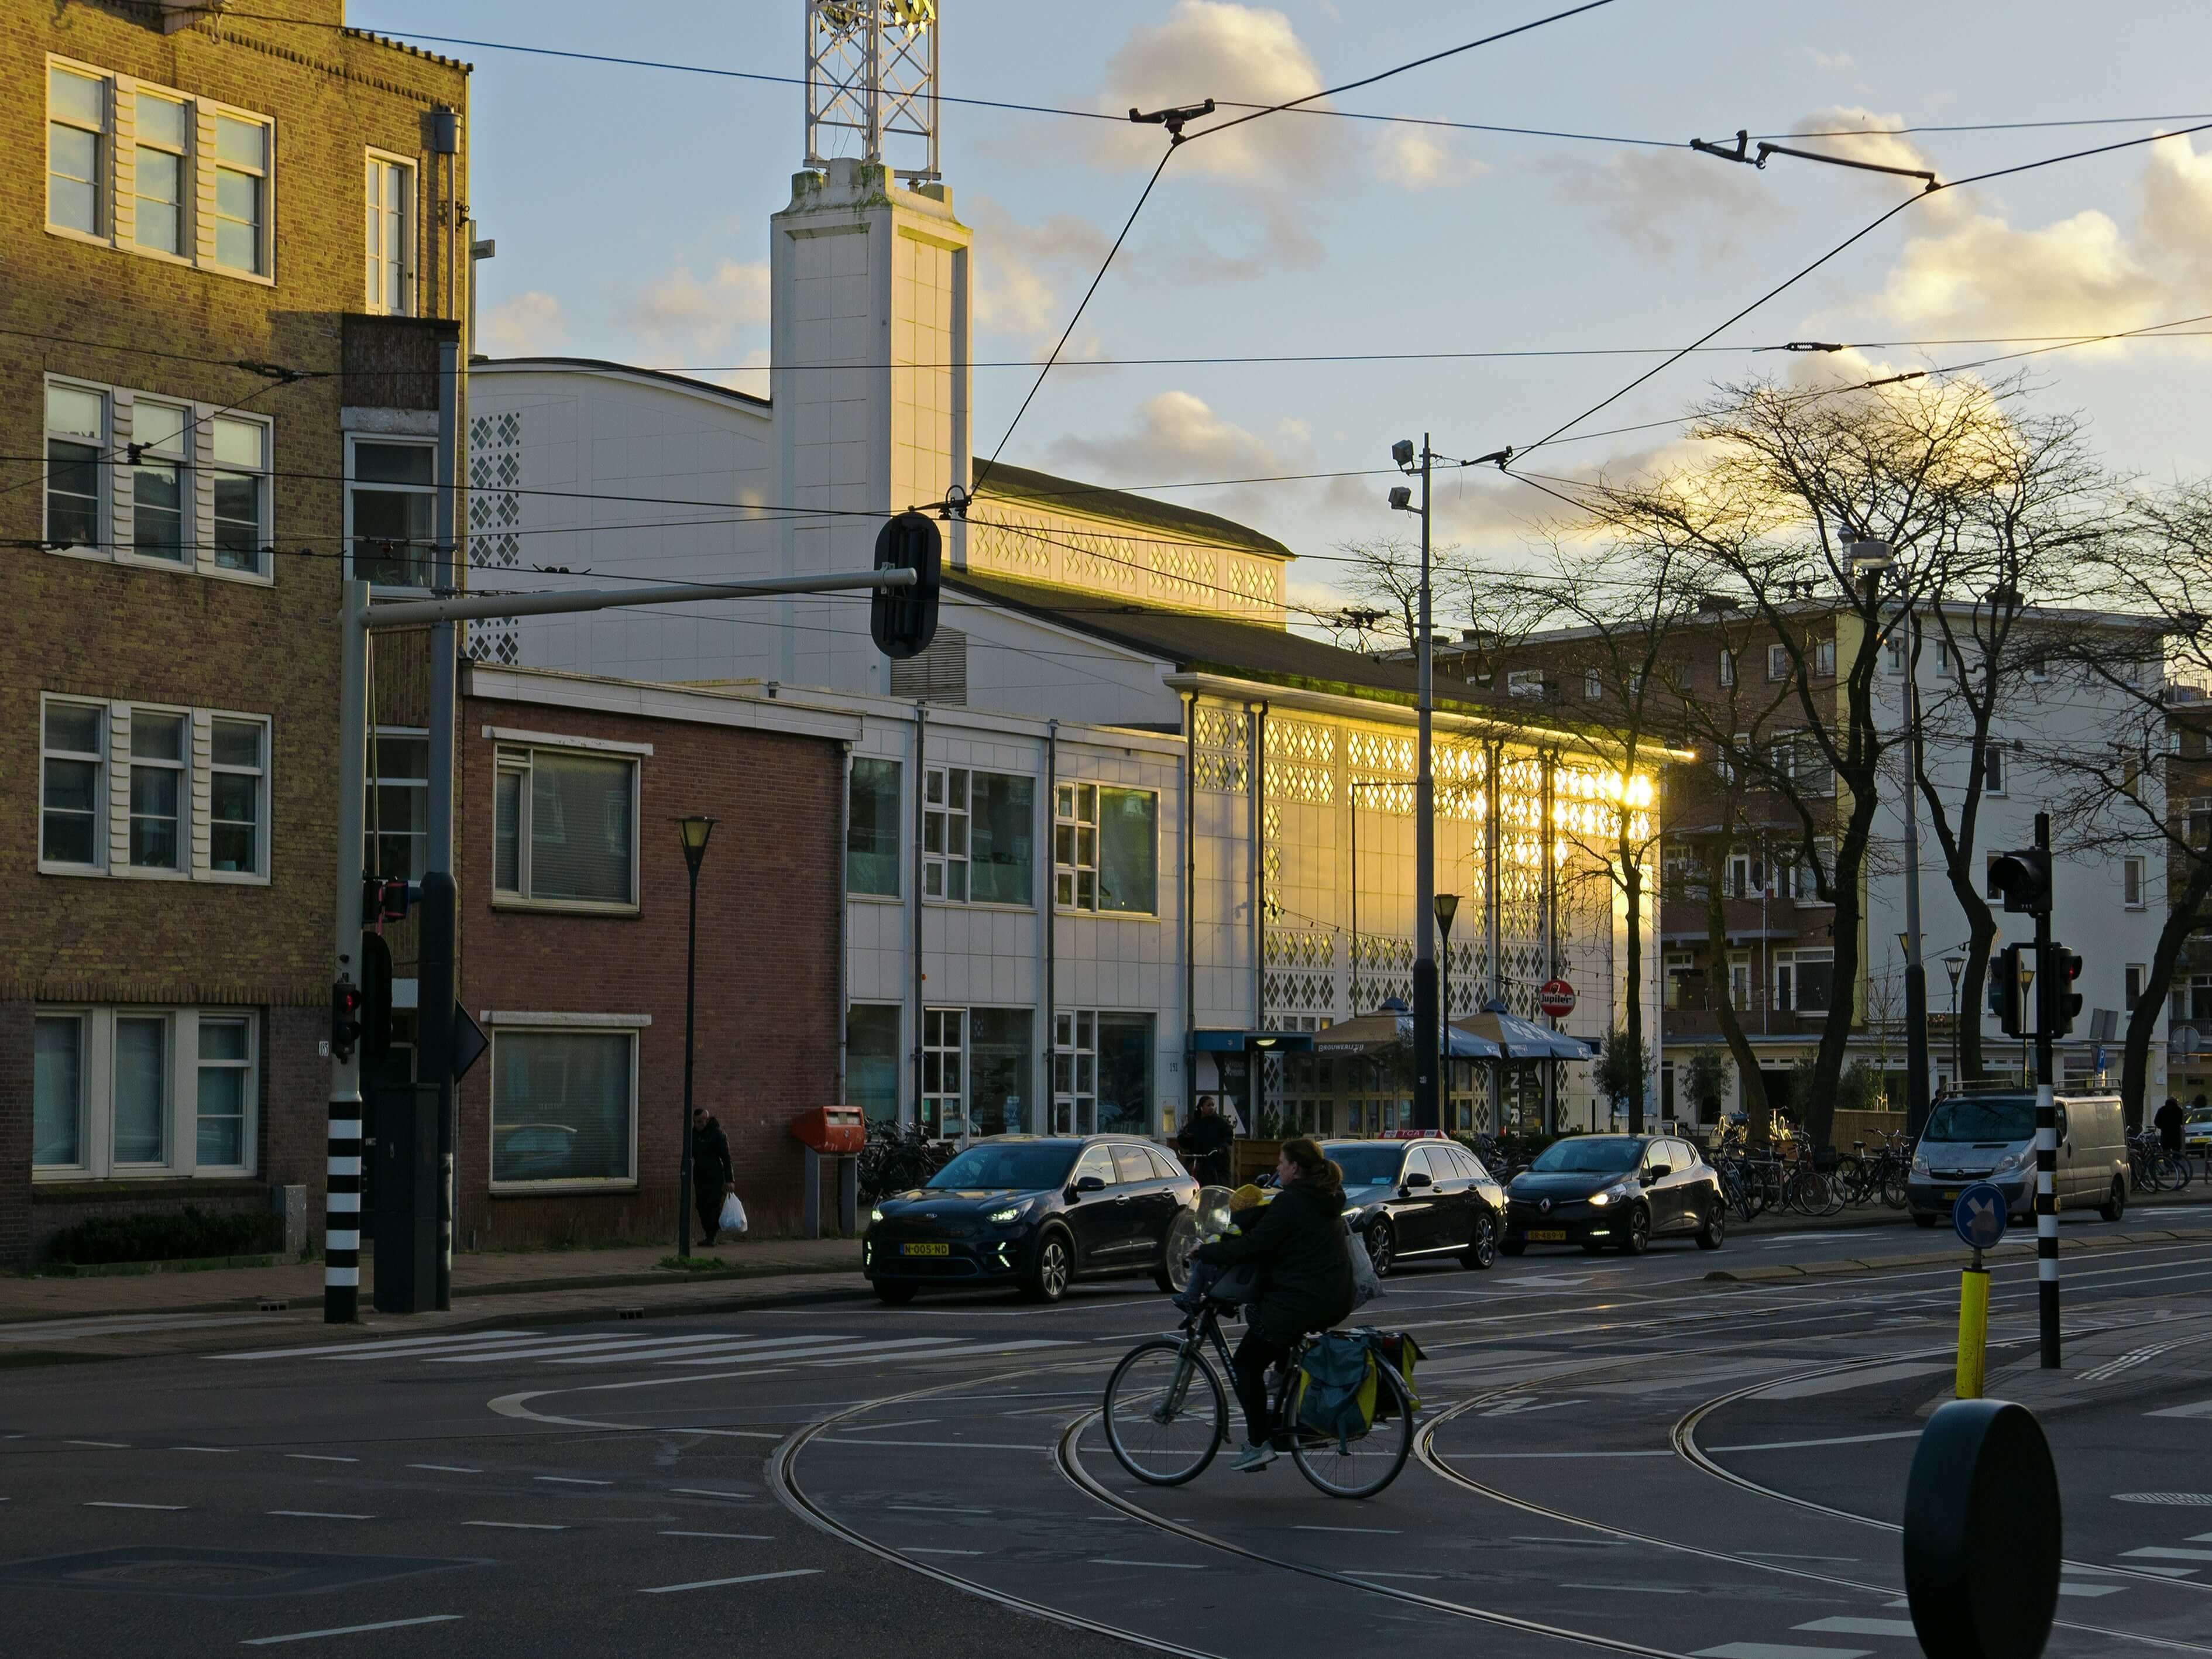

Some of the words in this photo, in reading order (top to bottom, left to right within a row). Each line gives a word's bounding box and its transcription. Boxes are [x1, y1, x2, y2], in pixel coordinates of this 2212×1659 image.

[1541, 995, 1571, 1003] Jupiler
[1318, 1044, 1353, 1052] BROUWERIJ
[905, 1245, 947, 1254] N-005-ND
